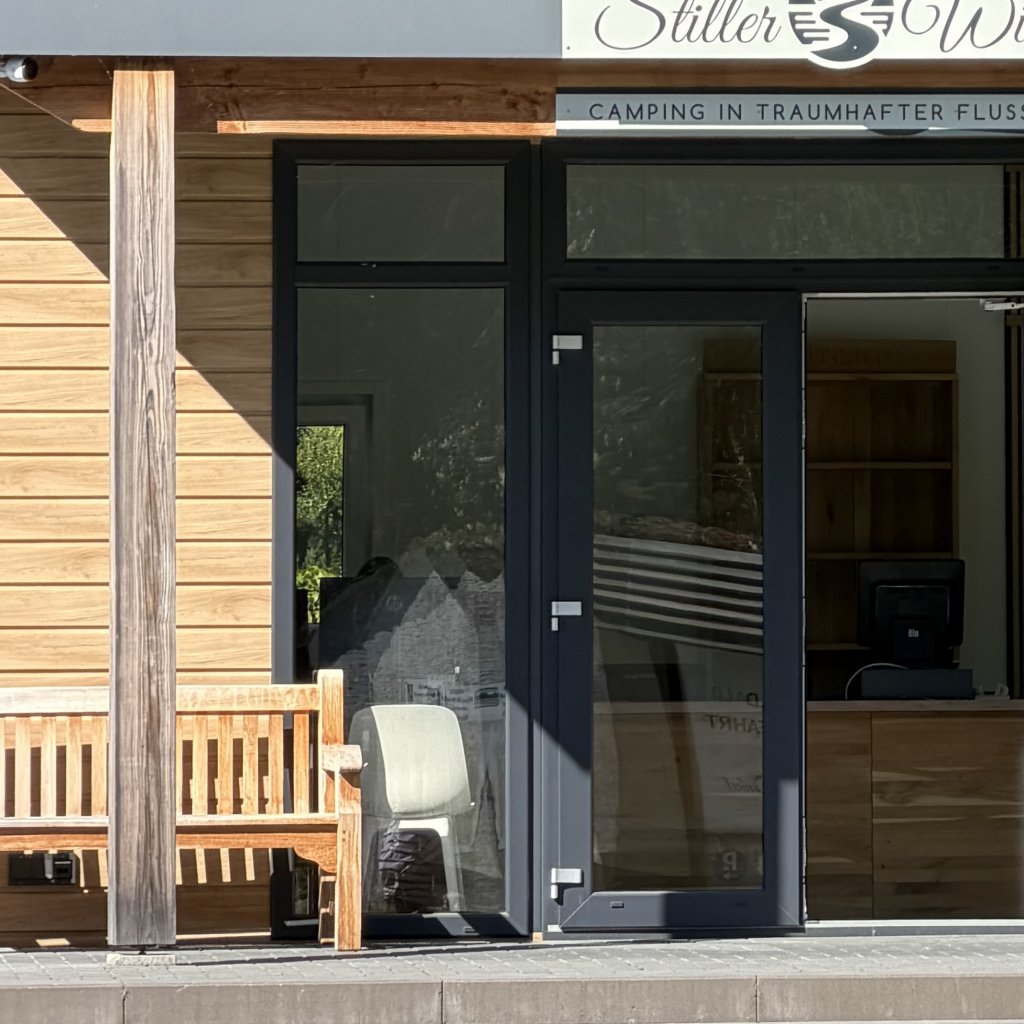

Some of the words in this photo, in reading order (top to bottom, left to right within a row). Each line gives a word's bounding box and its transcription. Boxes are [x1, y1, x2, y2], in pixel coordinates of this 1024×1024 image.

[588, 104, 706, 121] CAMPING
[719, 104, 743, 121] IN
[758, 104, 944, 121] TRAUMHAFTER
